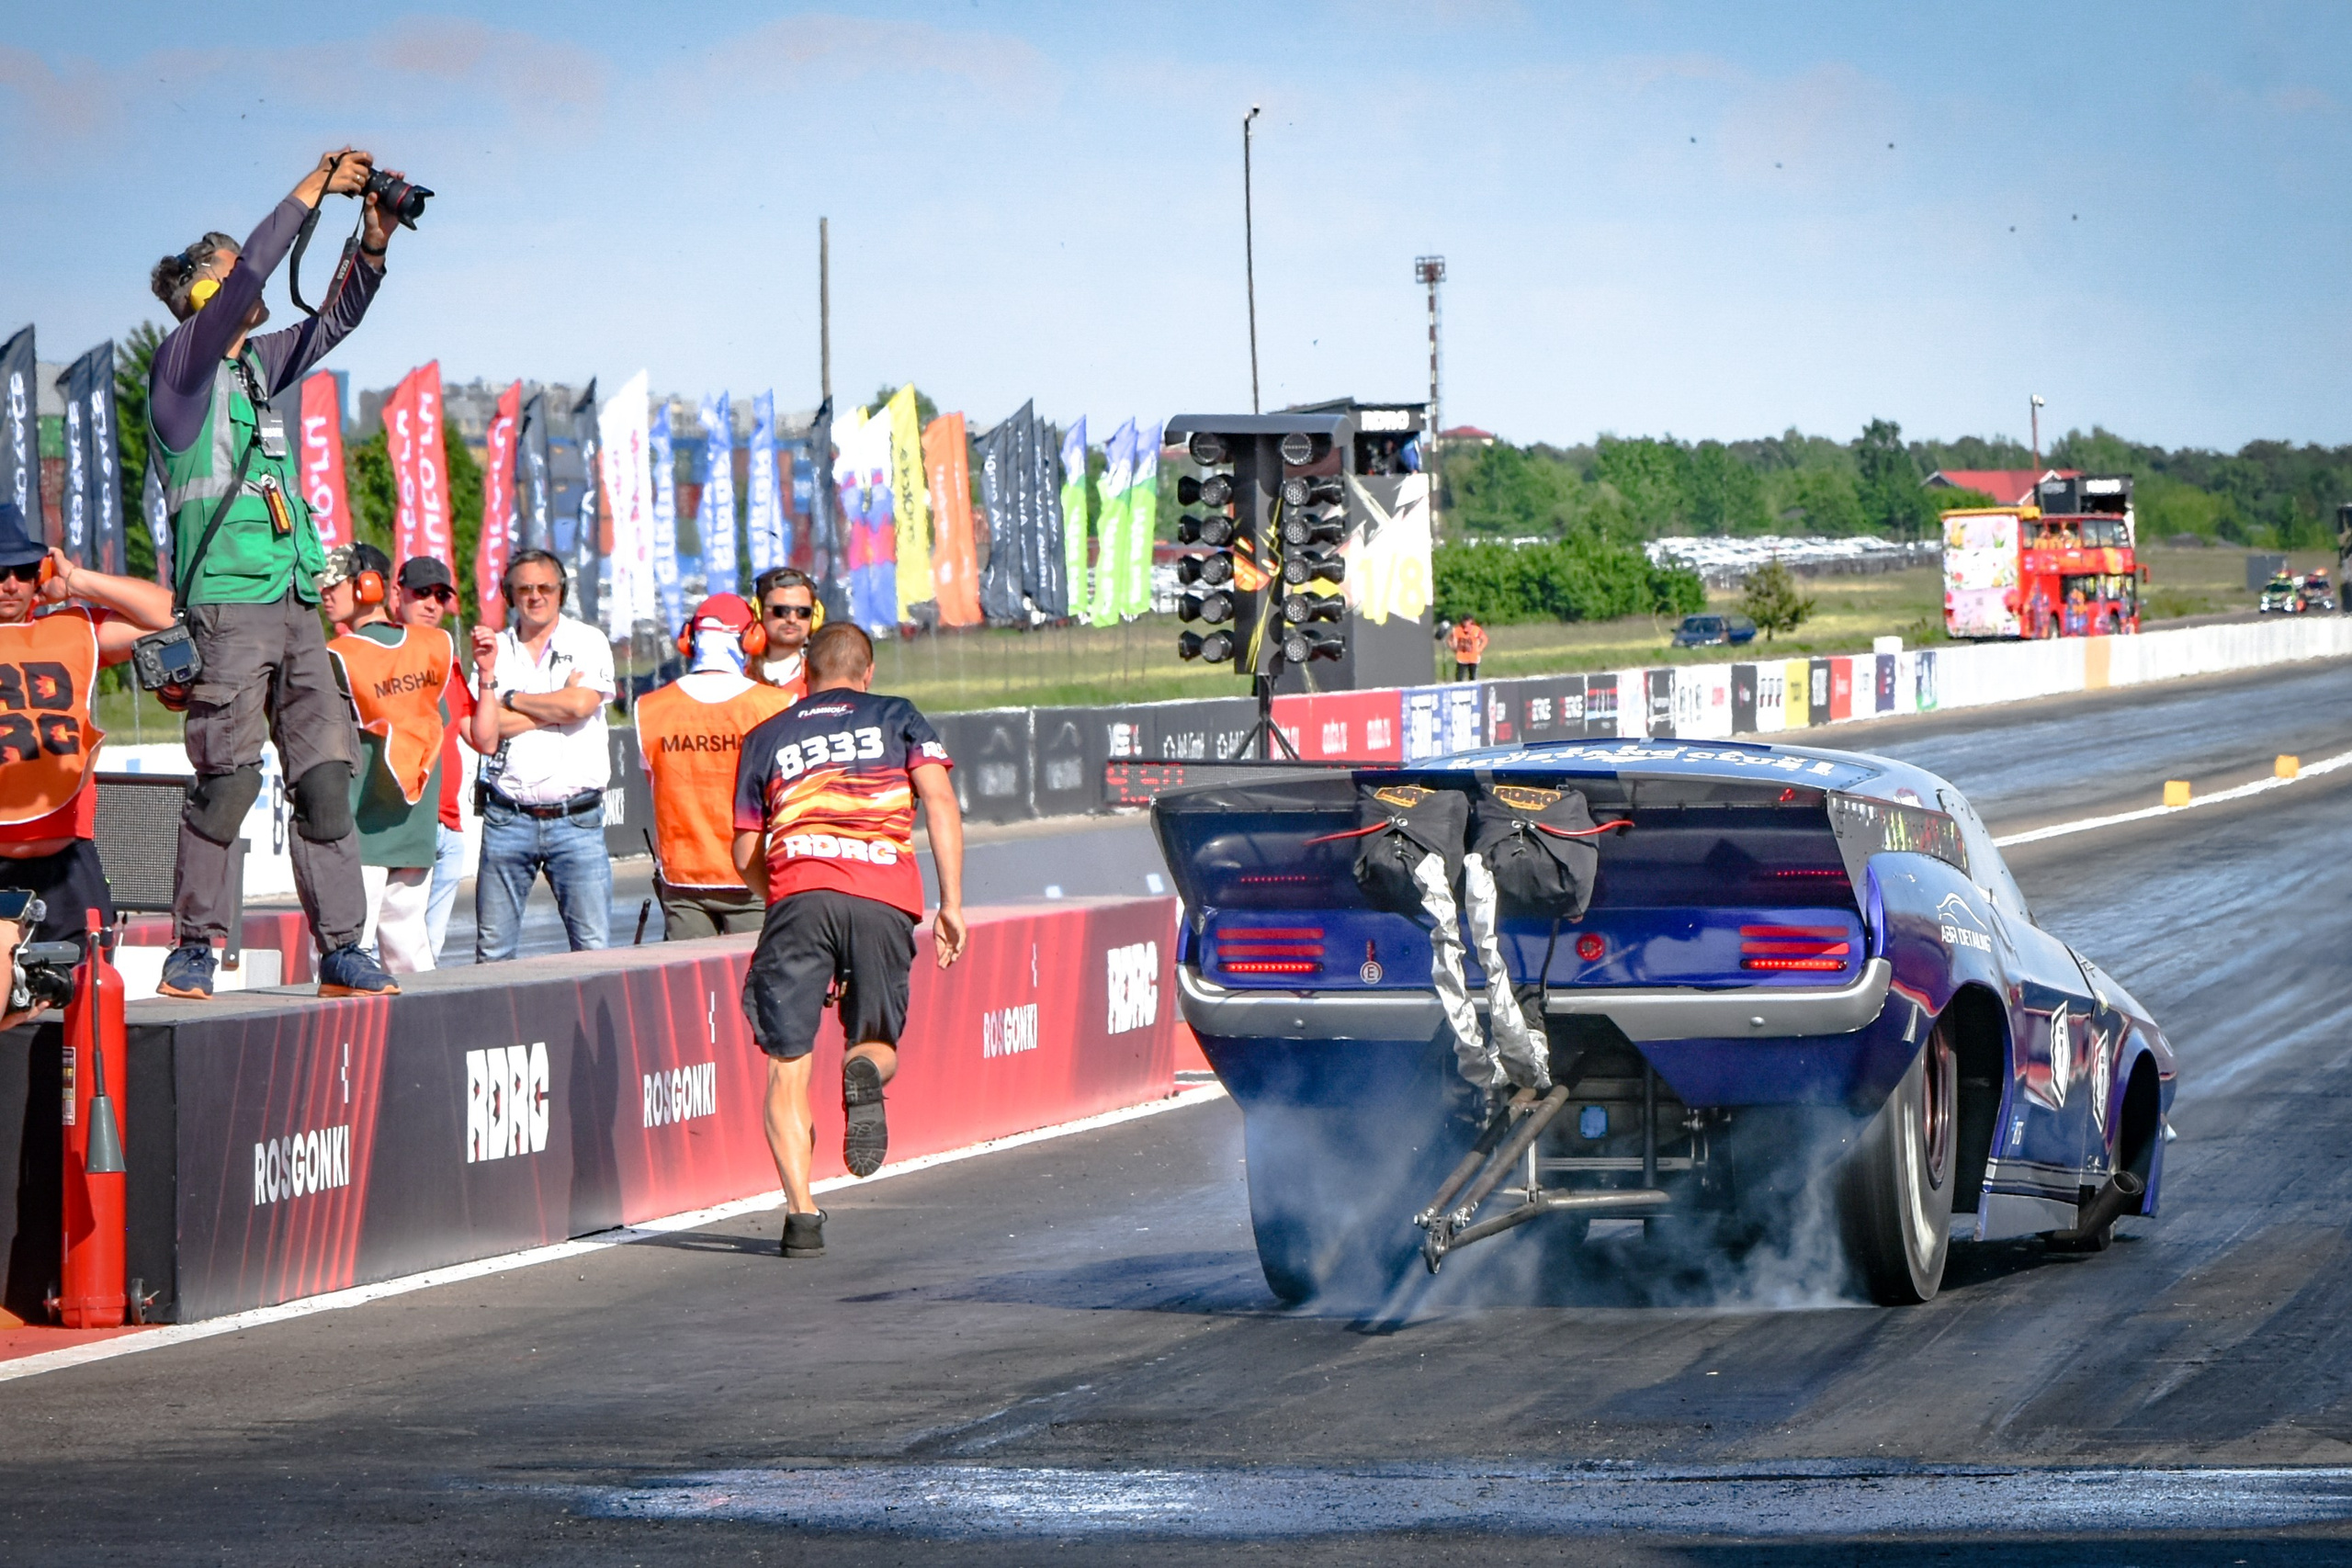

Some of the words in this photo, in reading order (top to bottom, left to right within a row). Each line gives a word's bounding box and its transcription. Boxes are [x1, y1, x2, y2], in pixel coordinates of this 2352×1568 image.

[1358, 552, 1426, 626] 1/8
[374, 670, 439, 699] MARSHAL
[775, 727, 885, 780] 8333
[783, 833, 898, 865] RDRC
[983, 1003, 1037, 1058] ROSGONKI
[466, 1042, 549, 1163] RDRC
[643, 1062, 716, 1128] ROSGONKI
[254, 1124, 349, 1206] ROSGONKI
